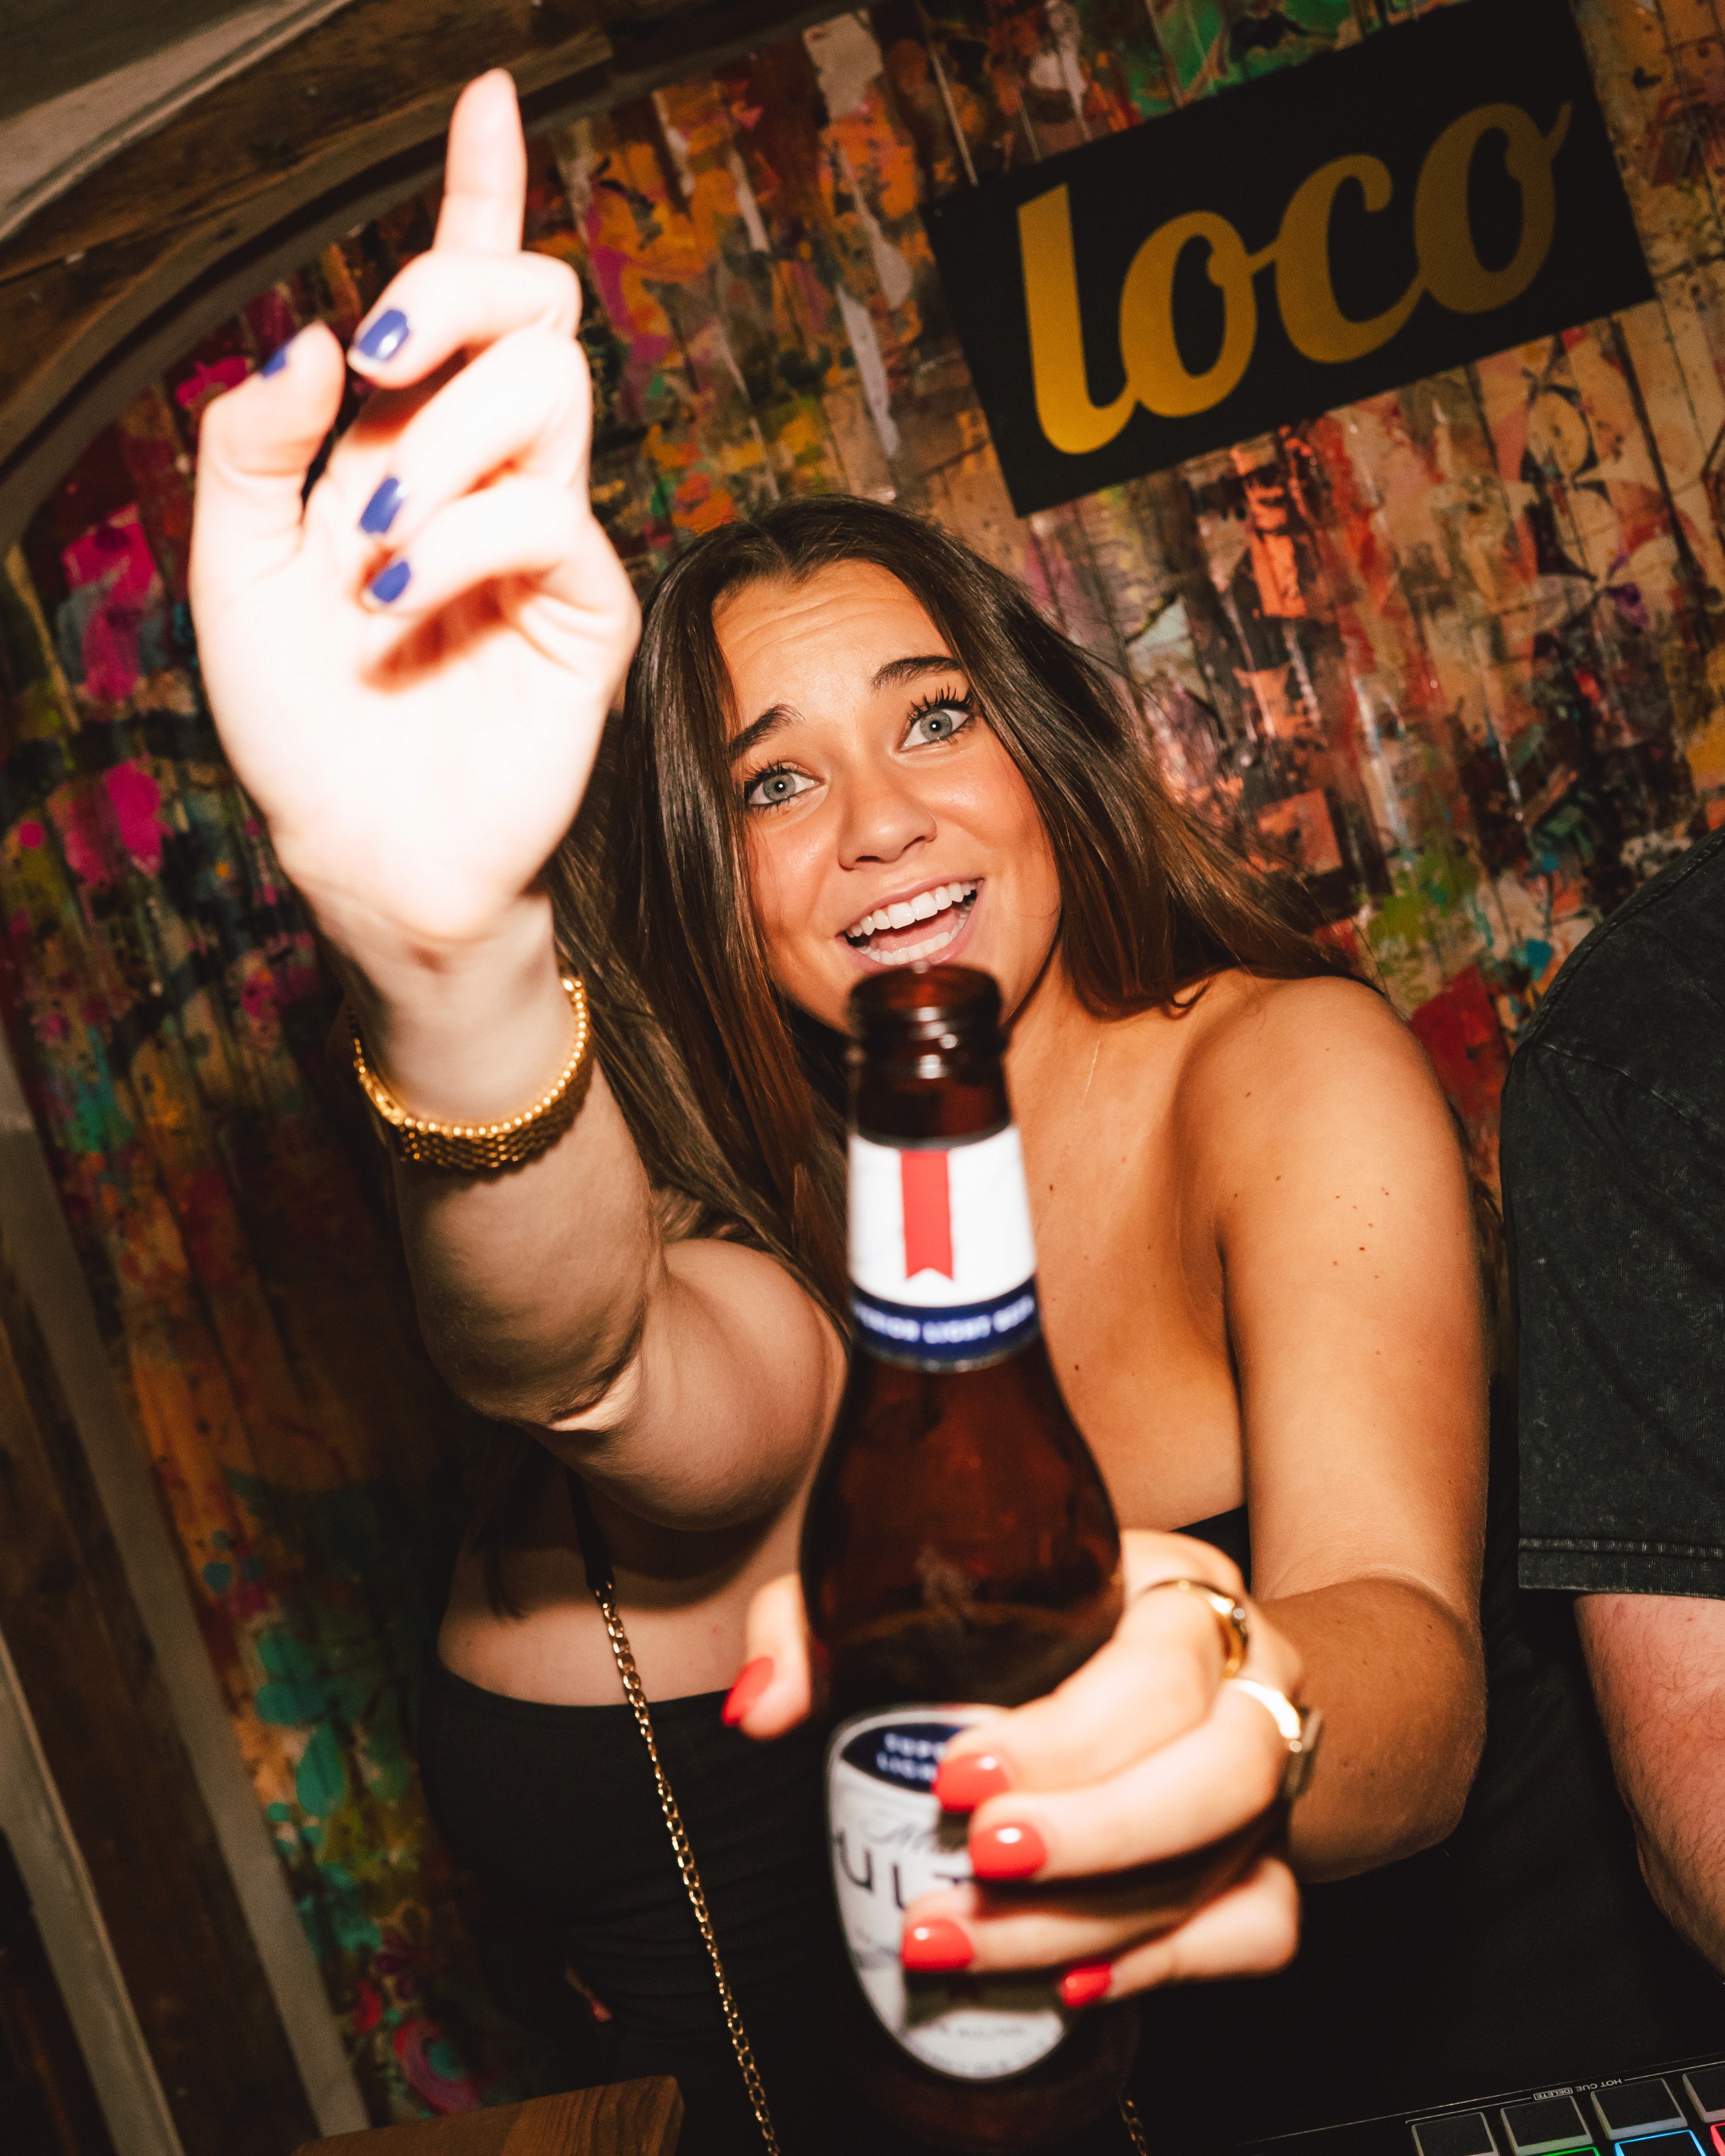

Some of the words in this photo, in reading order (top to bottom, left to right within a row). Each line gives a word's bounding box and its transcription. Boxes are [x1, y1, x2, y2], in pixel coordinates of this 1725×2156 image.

[1018, 102, 1572, 454] loco
[1575, 2083, 1598, 2092] CUE
[1600, 2078, 1622, 2088] HOT
[1536, 2088, 1571, 2099] DELETE
